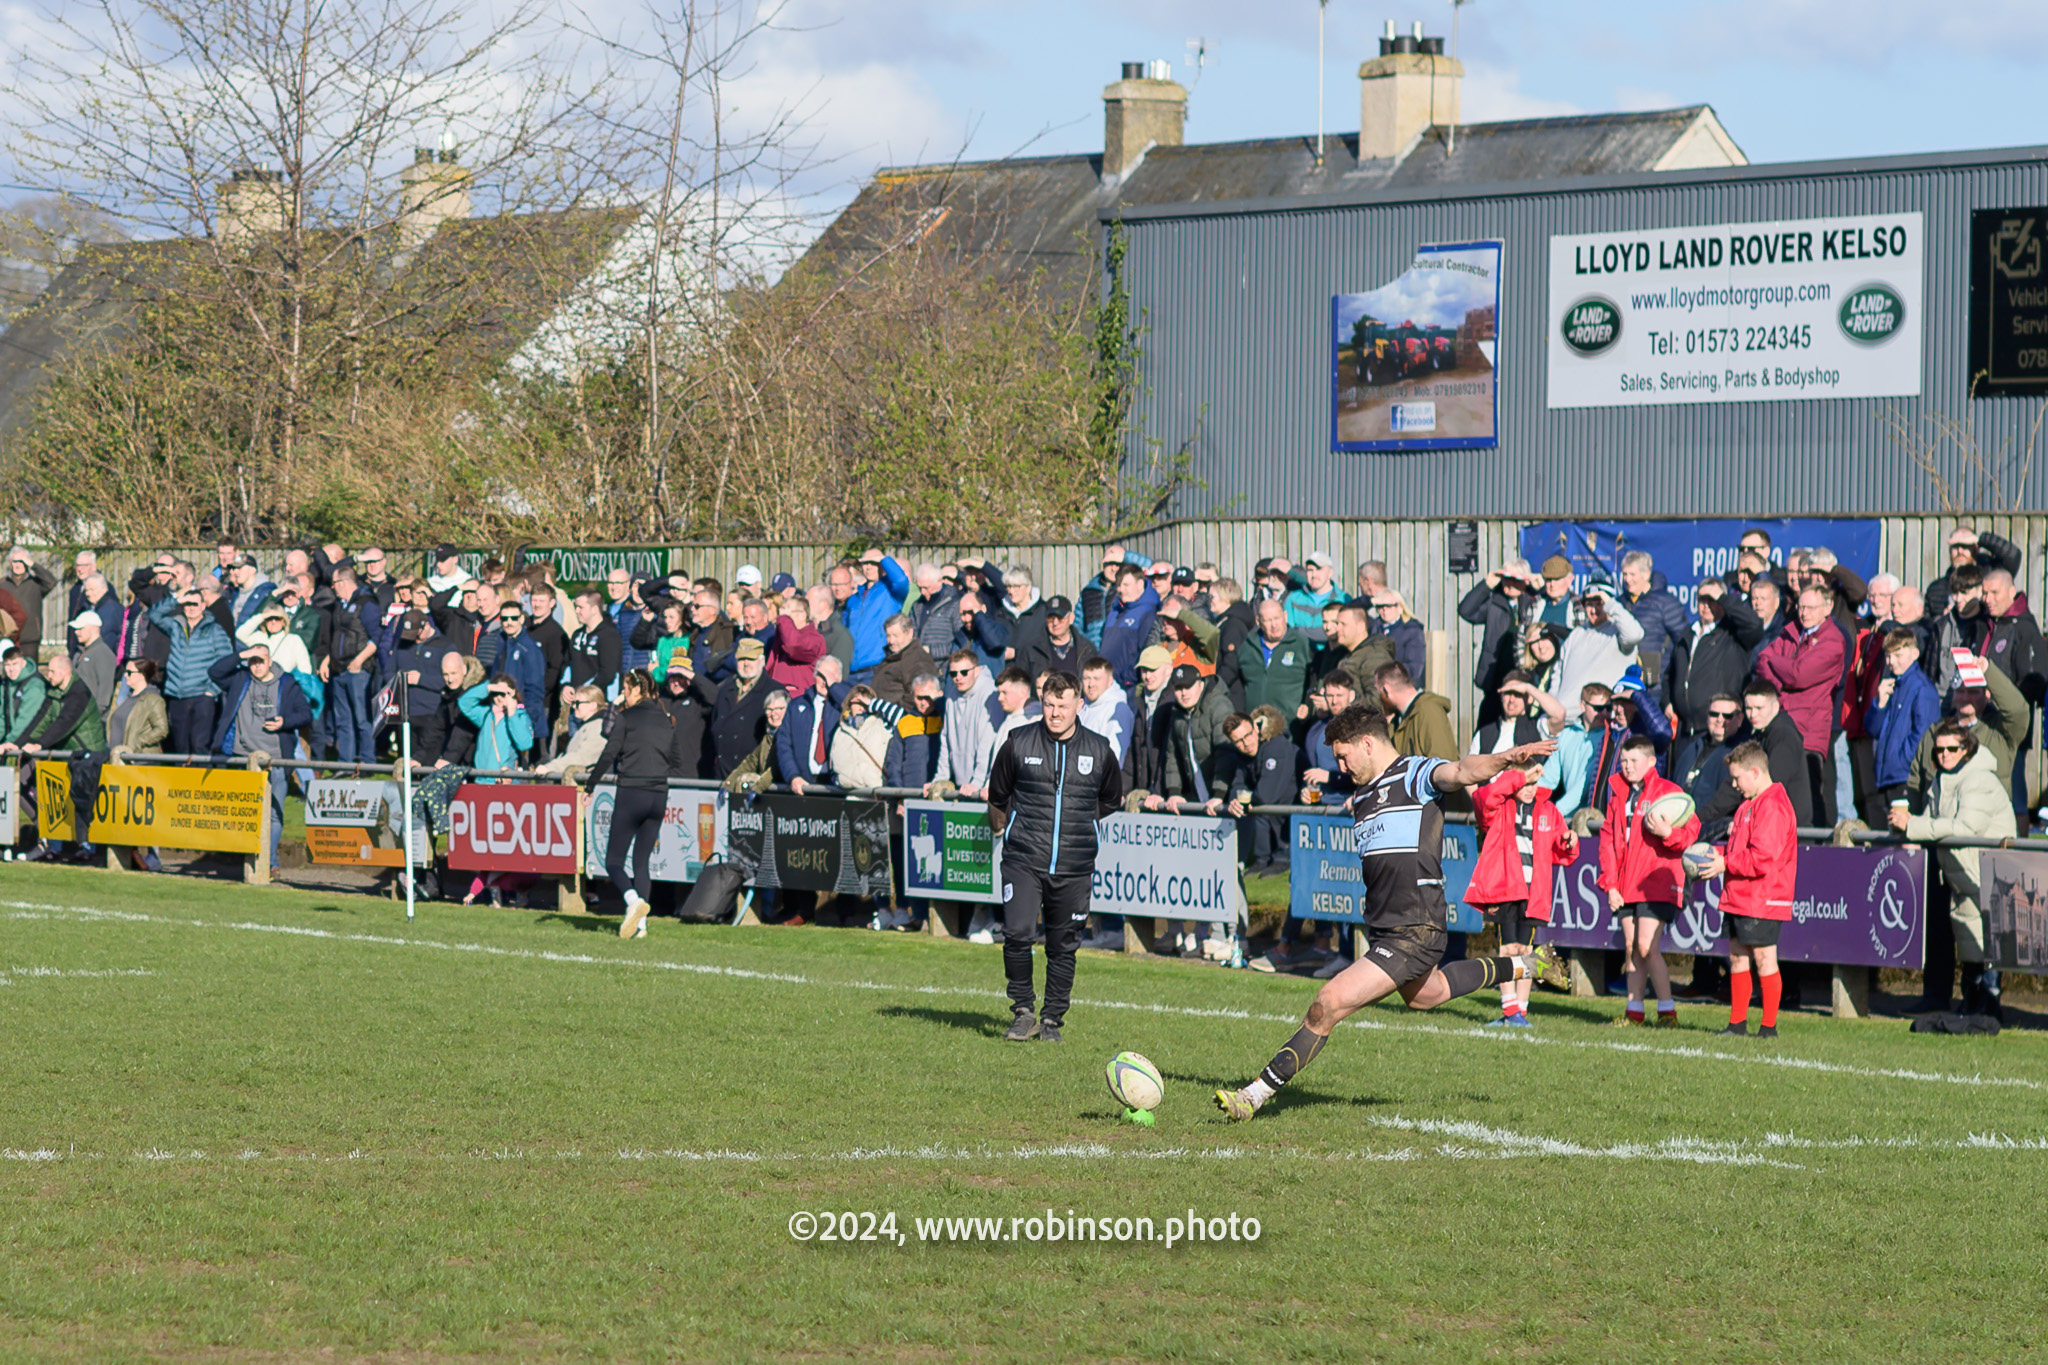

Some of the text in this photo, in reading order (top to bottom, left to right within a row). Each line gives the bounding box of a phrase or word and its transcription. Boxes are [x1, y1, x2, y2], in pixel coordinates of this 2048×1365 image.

[1575, 225, 1907, 275] LLOYD LAND ROVER KELSO
[1412, 258, 1490, 278] cultural Contractor
[1631, 283, 1831, 313] www.lloydmotorgroup.com
[1849, 293, 1885, 314] LAND
[2008, 286, 2048, 307] Vehicl
[1572, 306, 1604, 325] LAND
[1852, 312, 1895, 334] ROVER
[2012, 314, 2048, 335] Servi
[1574, 324, 1613, 344] ROVER
[1648, 324, 1812, 356] Tel: 01573 224345
[2017, 348, 2048, 369] 078
[1620, 365, 1840, 393] Sales, Servicing, Parts & Bodyshop
[1403, 415, 1434, 426] Facebook
[123, 785, 155, 826] JCB
[168, 788, 260, 803] ALNWICK EDINBURGH NEWCASTLE
[177, 803, 258, 818] CARLISLE DUMFRIES GLASGOW
[731, 810, 763, 831] BELHAVEN
[171, 817, 192, 828] DUNDEE
[194, 818, 220, 830] ABERDEEN
[448, 800, 573, 857] PLEXUS
[777, 816, 799, 836] PROUD
[808, 818, 838, 838] SUPPORT
[946, 821, 991, 841] BORDER
[1112, 822, 1142, 846] SALE
[1146, 825, 1225, 851] SPECIALISTS
[787, 848, 810, 871] KELSO
[947, 848, 991, 864] LIVESTOCK
[947, 868, 991, 885] EXCHANGE
[1320, 860, 1362, 883] Remov
[1867, 854, 1894, 902] PROPERTY
[1091, 861, 1225, 910] estock.co.uk
[1312, 892, 1353, 915] KELSO
[1792, 894, 1848, 924] egal.co.uk
[1869, 922, 1888, 959] LEGAL
